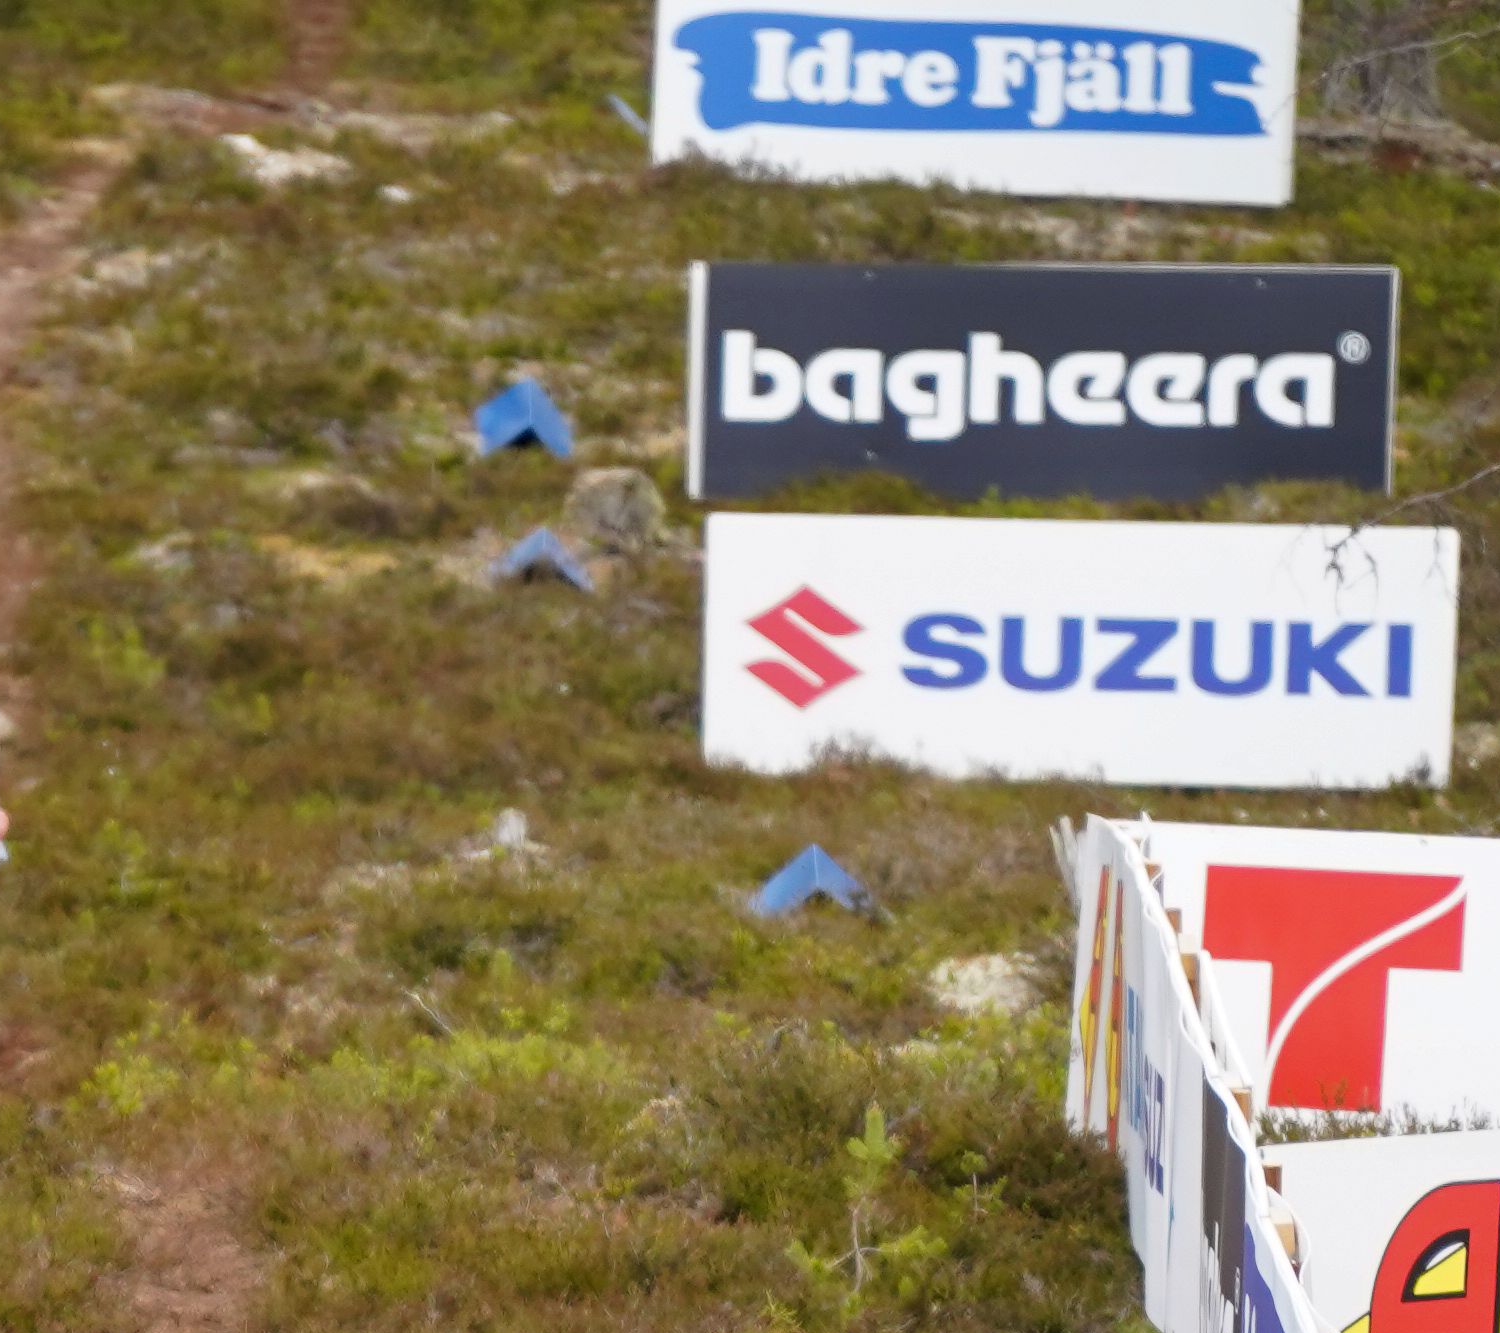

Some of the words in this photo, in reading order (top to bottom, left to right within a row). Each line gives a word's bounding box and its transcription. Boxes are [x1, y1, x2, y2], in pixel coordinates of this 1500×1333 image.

[751, 28, 955, 108] Idre
[971, 38, 1196, 129] Fjäll
[720, 329, 1337, 443] bagheera
[900, 612, 1415, 699] SUZUKI
